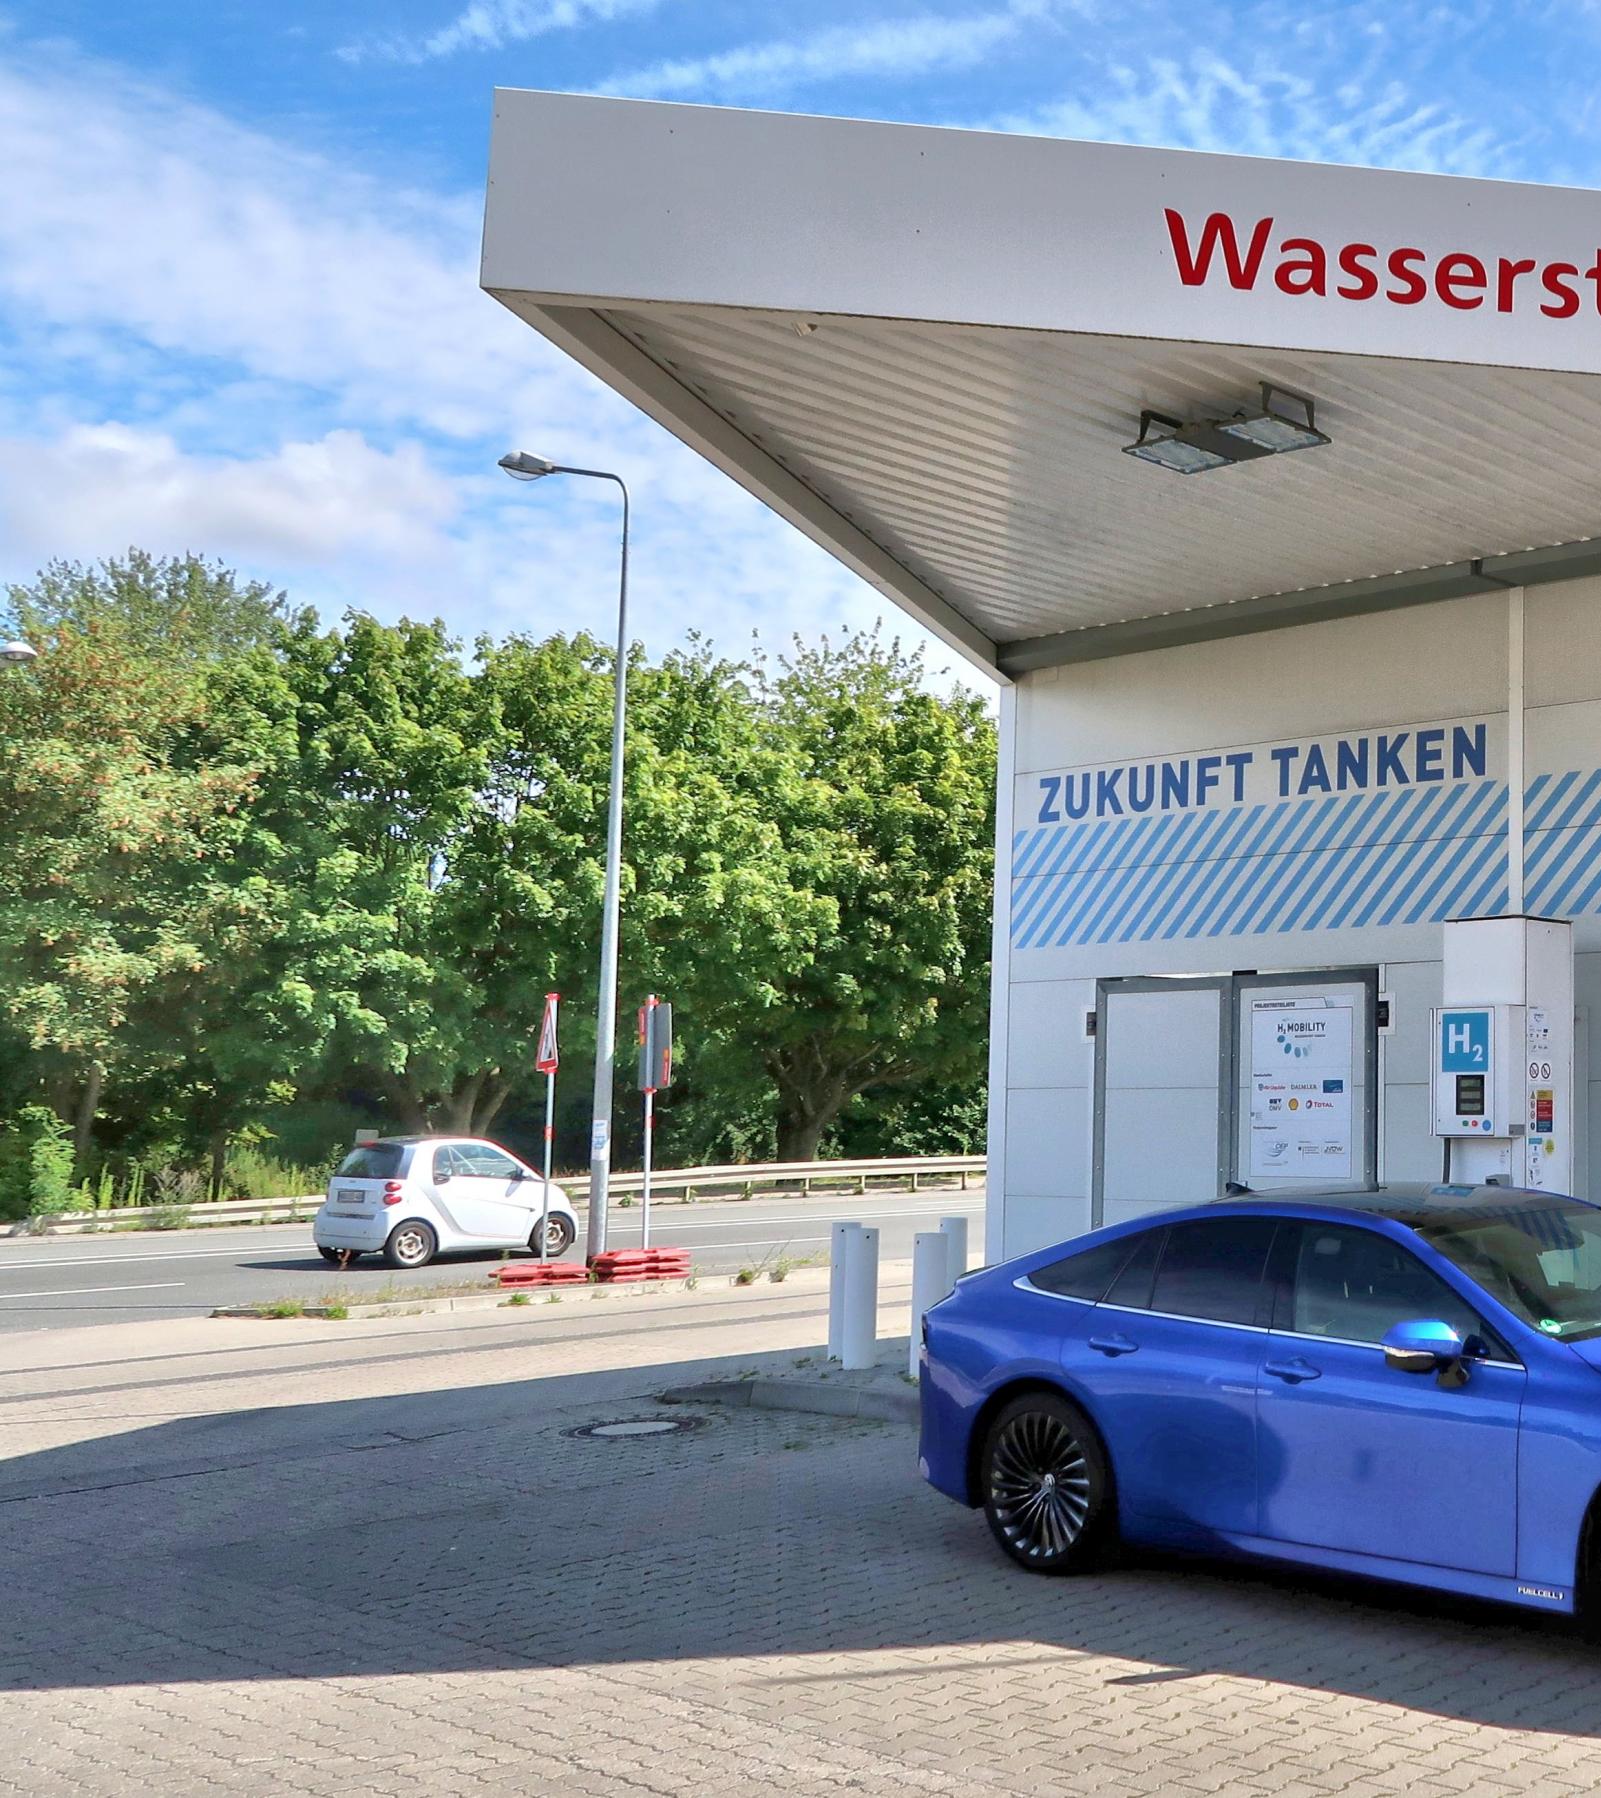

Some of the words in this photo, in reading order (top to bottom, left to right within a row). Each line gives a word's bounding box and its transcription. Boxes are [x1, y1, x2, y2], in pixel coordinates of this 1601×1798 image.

[1038, 752, 1254, 824] ZUKUNFT
[1271, 723, 1487, 797] TANKEN
[1287, 1022, 1327, 1033] MOBILITY
[1448, 1023, 1484, 1062] H2
